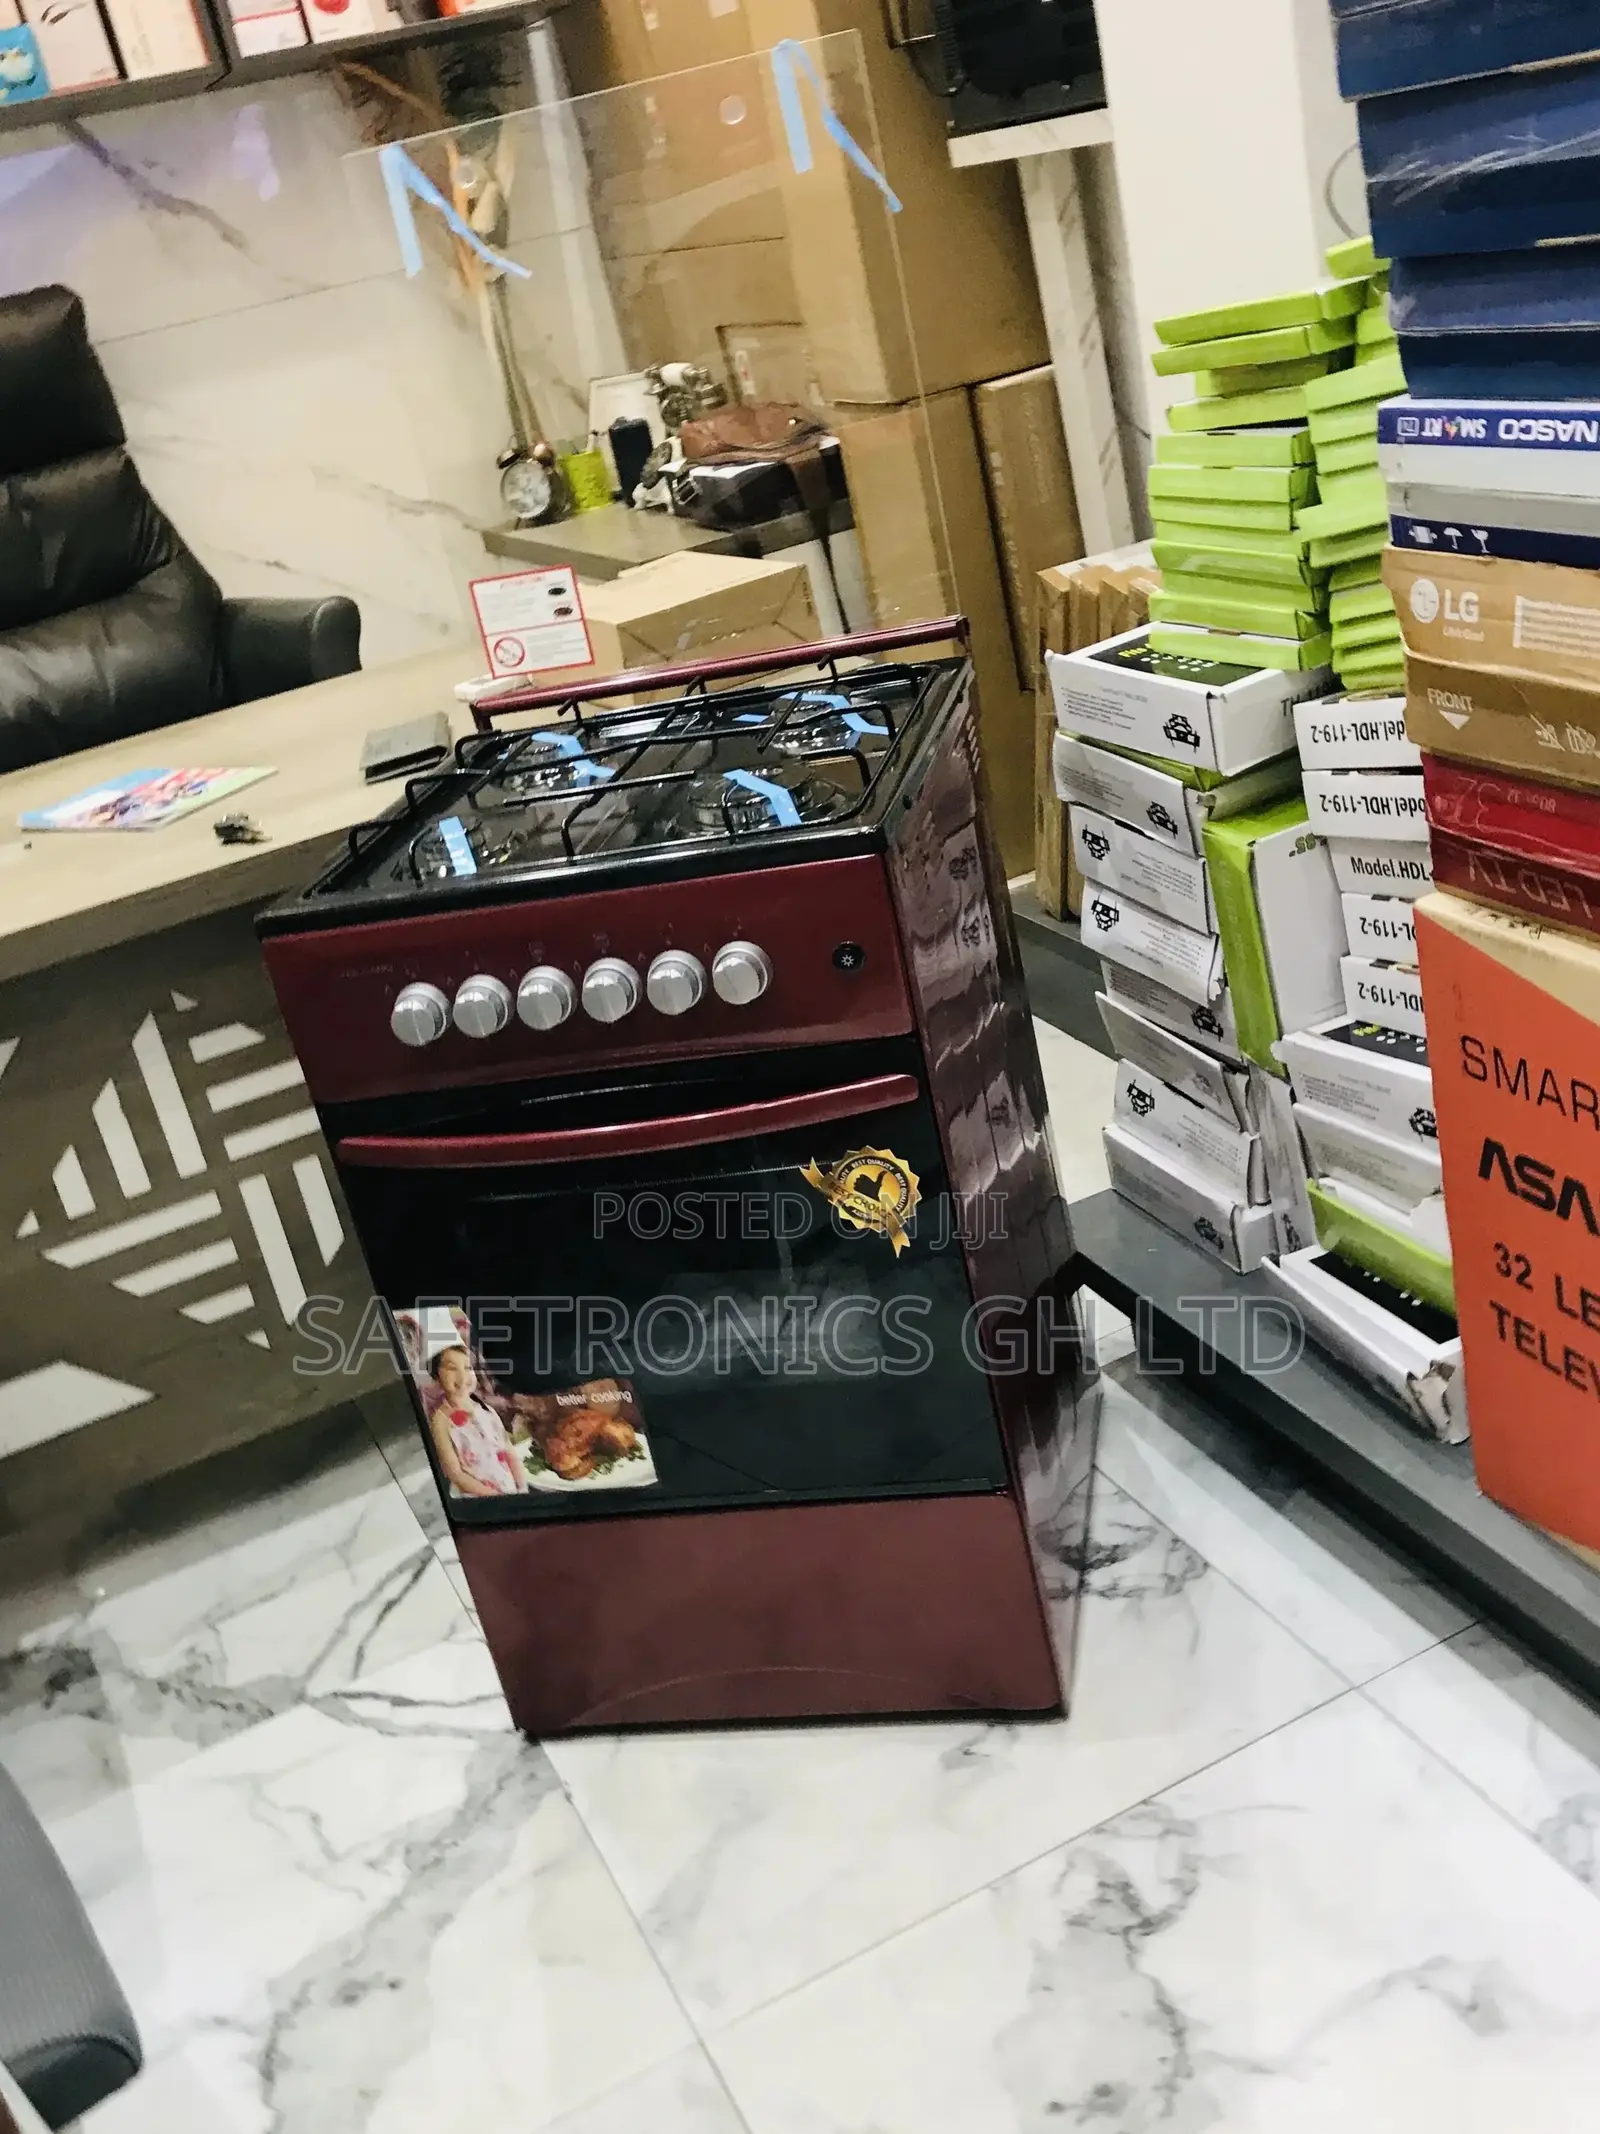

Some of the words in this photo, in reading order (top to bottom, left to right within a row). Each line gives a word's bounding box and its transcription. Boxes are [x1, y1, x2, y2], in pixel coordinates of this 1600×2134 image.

[1498, 418, 1598, 443] NASCO
[1443, 588, 1479, 624] LG
[1427, 688, 1473, 712] FRONT
[1468, 852, 1517, 894] TV
[1518, 868, 1593, 919] LED
[851, 1158, 866, 1169] BEST
[866, 1158, 895, 1171] QUALITY
[1493, 1242, 1534, 1292] 32
[555, 1392, 588, 1407] better
[590, 1389, 633, 1404] cooking
